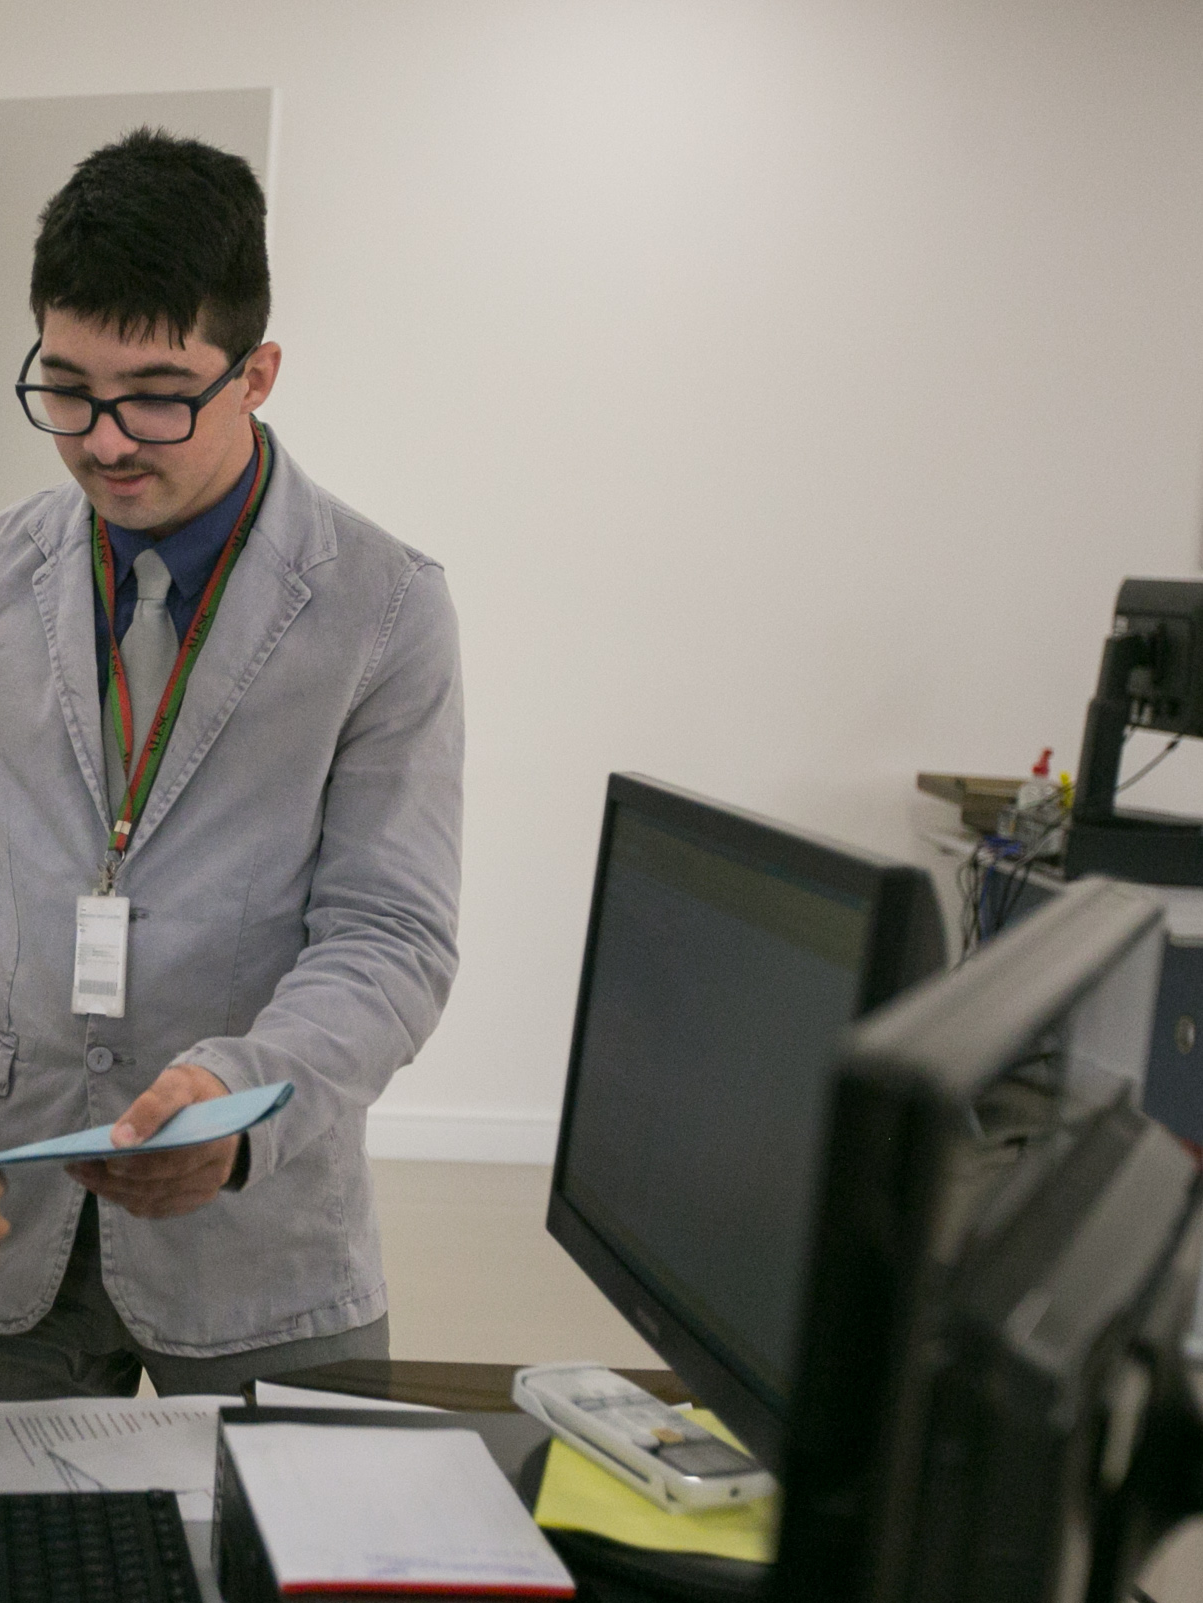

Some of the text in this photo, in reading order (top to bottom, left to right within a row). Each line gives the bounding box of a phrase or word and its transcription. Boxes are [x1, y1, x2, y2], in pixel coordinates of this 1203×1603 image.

[96, 528, 109, 568] ALESC
[186, 608, 210, 652] ALESC
[148, 711, 169, 756] ALESC
